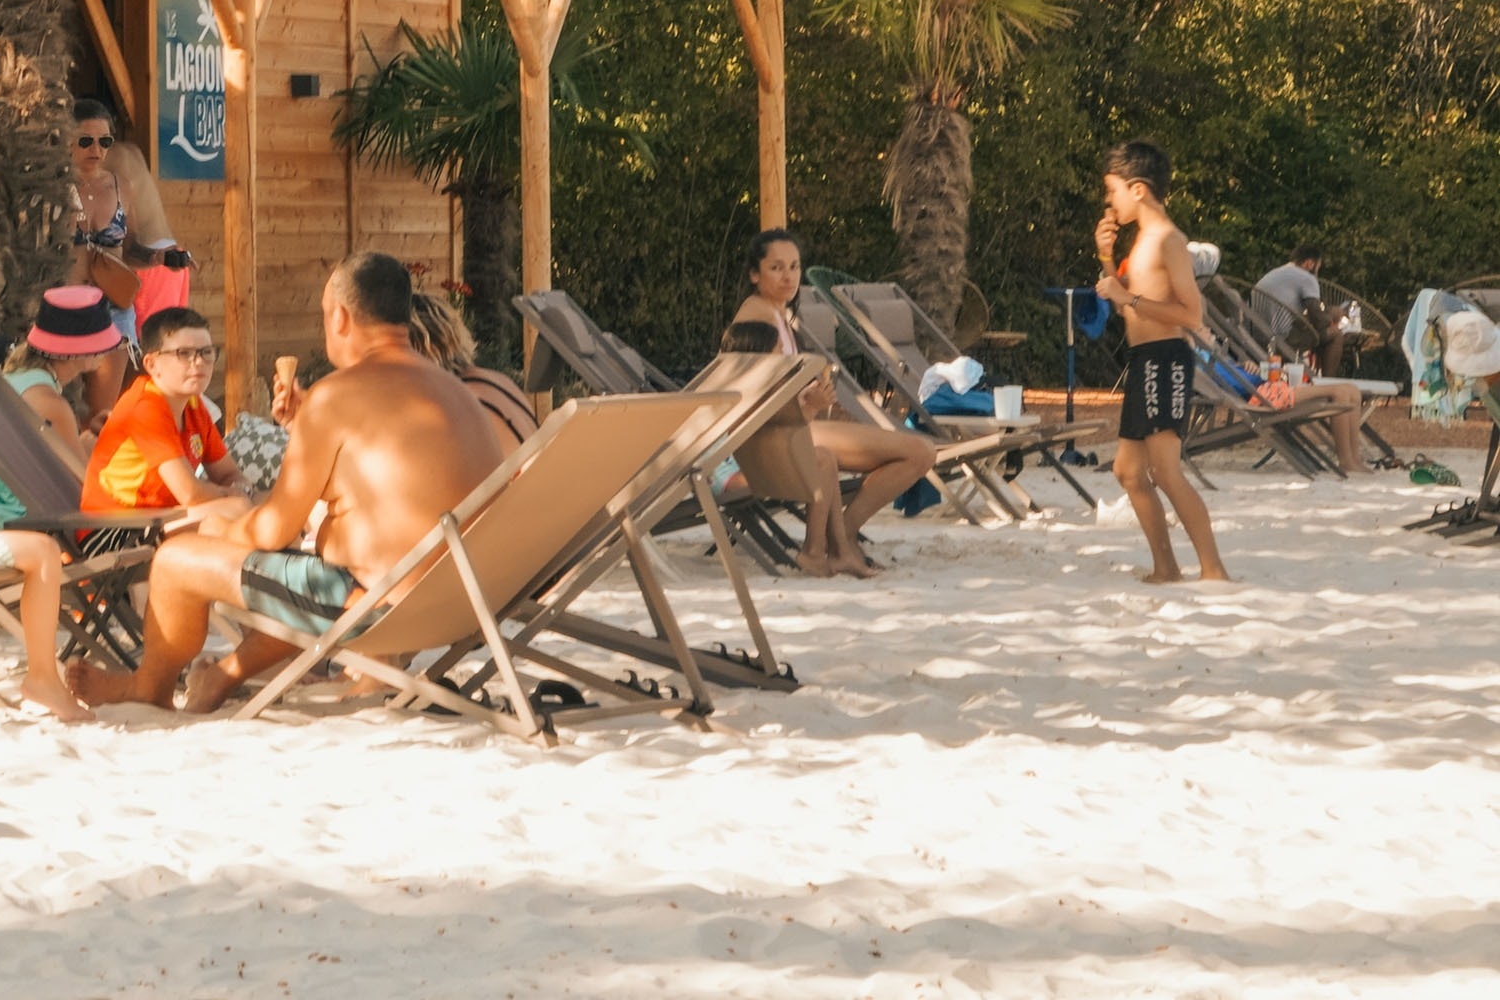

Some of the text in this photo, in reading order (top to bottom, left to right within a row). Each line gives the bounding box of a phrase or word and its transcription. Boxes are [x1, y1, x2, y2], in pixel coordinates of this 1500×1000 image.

[165, 42, 225, 92] LAGOON
[195, 95, 225, 148] BAR
[1171, 361, 1185, 419] JONES
